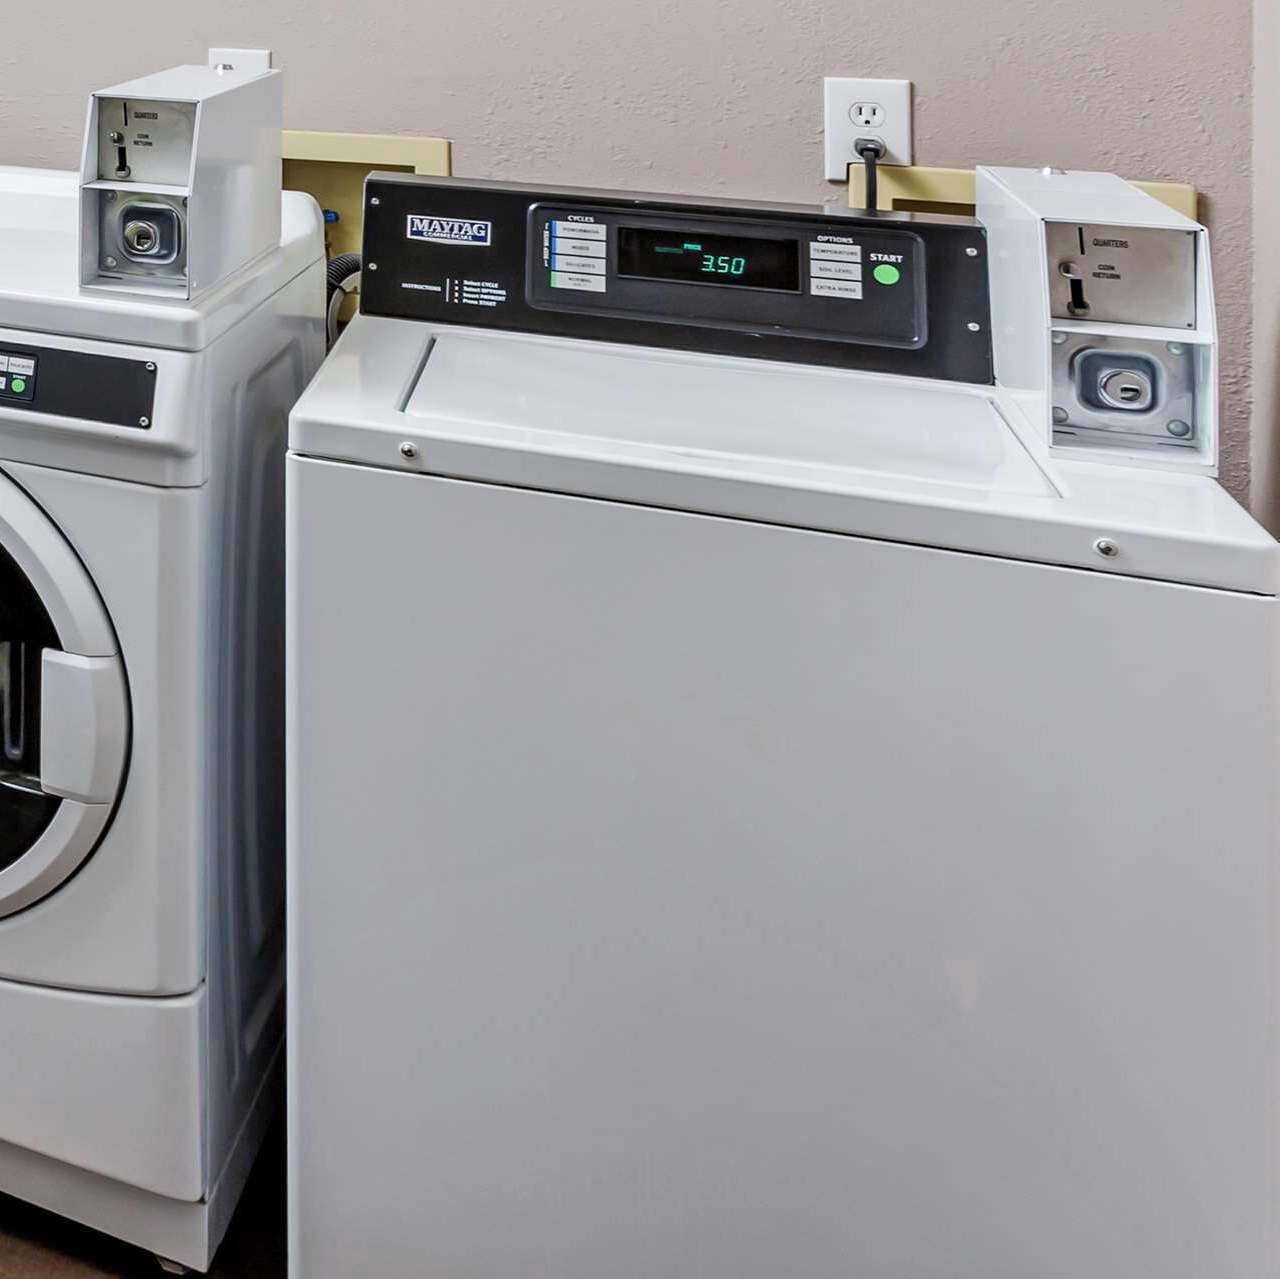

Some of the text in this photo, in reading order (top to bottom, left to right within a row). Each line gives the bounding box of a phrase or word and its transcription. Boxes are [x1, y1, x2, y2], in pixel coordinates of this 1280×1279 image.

[567, 214, 595, 223] CYCLES
[411, 218, 486, 236] MAYTAG
[817, 235, 854, 244] OPTIONS
[1092, 238, 1129, 249] QUARTERS
[813, 247, 858, 256] TEMPERATURE
[869, 253, 904, 263] START
[701, 254, 745, 274] 3.50
